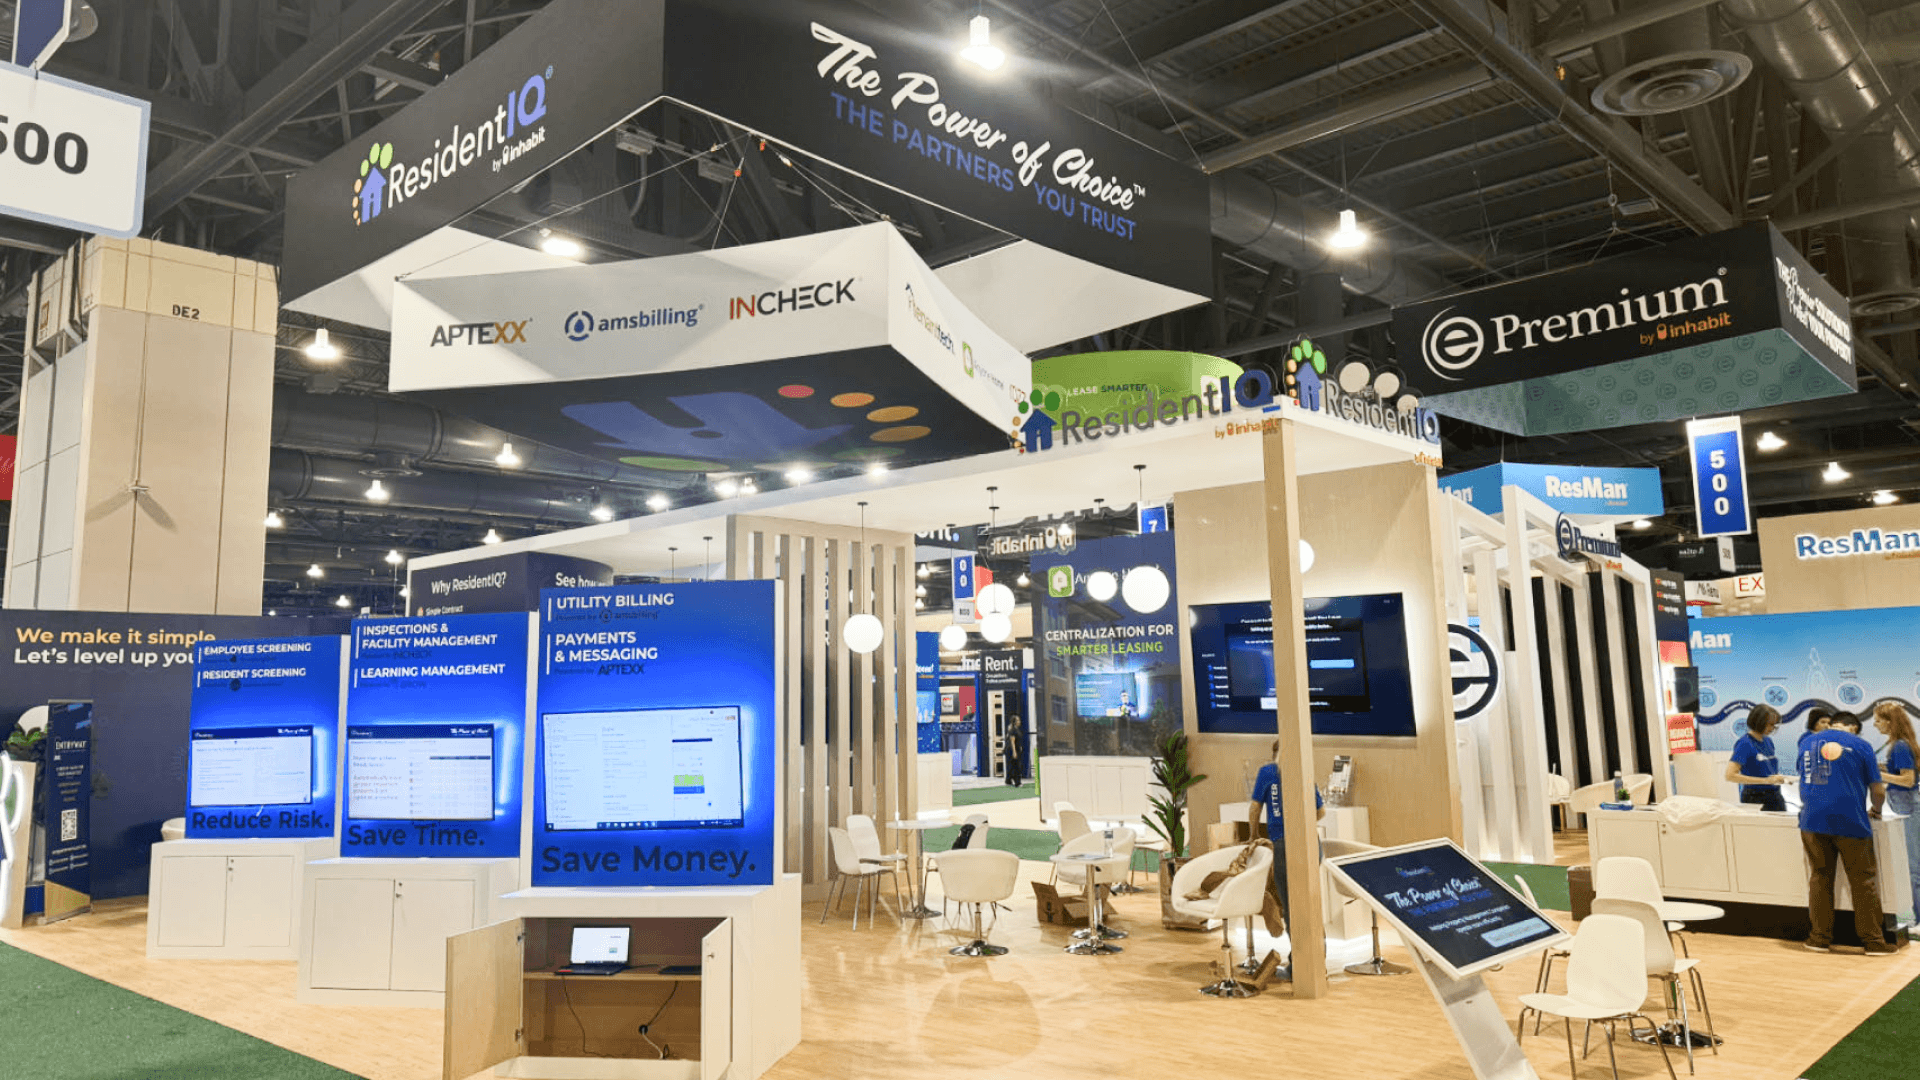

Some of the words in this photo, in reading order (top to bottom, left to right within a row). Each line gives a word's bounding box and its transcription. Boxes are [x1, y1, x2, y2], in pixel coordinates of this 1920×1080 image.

[811, 21, 882, 97] The
[891, 72, 1007, 150] Power
[1012, 141, 1051, 187] of
[0, 114, 89, 175] 00
[510, 126, 546, 162] inhabit
[830, 91, 884, 137] THE
[893, 119, 1015, 193] PARTNERS
[1033, 181, 1075, 218] YOU
[1080, 201, 1137, 241] TRUST
[730, 278, 855, 320] INCHECK
[172, 303, 200, 320] DE2
[598, 307, 699, 332] amsbilling
[430, 320, 528, 347] APTEXX
[1640, 332, 1655, 346] by
[1669, 312, 1732, 338] inhabit
[1067, 385, 1097, 397] LEASE
[1061, 369, 1275, 446] ResidentIQ
[1325, 378, 1440, 445] ResidentIQ
[1545, 475, 1628, 499] ResMan
[1709, 449, 1730, 516] 500
[1796, 529, 1920, 558] ResMan
[431, 581, 451, 597] Why
[452, 572, 507, 591] ResidentIQ?
[555, 572, 576, 588] See
[442, 605, 464, 614] Contract
[557, 595, 612, 609] UTILITY
[615, 593, 675, 607] BILLING
[16, 627, 54, 643] We
[60, 628, 122, 644] make
[127, 628, 142, 644] it
[147, 628, 216, 649] simple
[362, 638, 411, 649] FACILITY
[413, 633, 498, 647] MANAGEMENT
[363, 623, 438, 636] INSPECTIONS
[440, 623, 449, 633] &
[555, 631, 637, 646] PAYMENTS
[1045, 625, 1145, 641] CENTRALIZATION
[1147, 624, 1174, 636] FOR
[14, 648, 68, 664] Let's
[73, 648, 124, 664] level
[130, 652, 157, 667] up
[203, 644, 255, 656] EMPLOYEE
[256, 642, 312, 653] SCREENING
[555, 650, 565, 663] &
[569, 647, 658, 662] MESSAGING
[1057, 643, 1109, 656] SMARTER
[1112, 641, 1164, 654] LEASING
[202, 668, 250, 680] RESIDENT
[251, 667, 307, 678] SCREENING
[360, 666, 418, 679] LEARNING
[421, 663, 506, 677] MANAGEMENT
[985, 655, 1019, 672] Rent.
[1804, 750, 1812, 784] BETTER
[1271, 783, 1282, 817] BETTER
[192, 811, 272, 829] Reduce
[279, 809, 330, 829] Risk.
[347, 825, 407, 846] Save
[413, 822, 485, 846] Time.
[541, 845, 621, 872] Save
[633, 845, 756, 879] Money.
